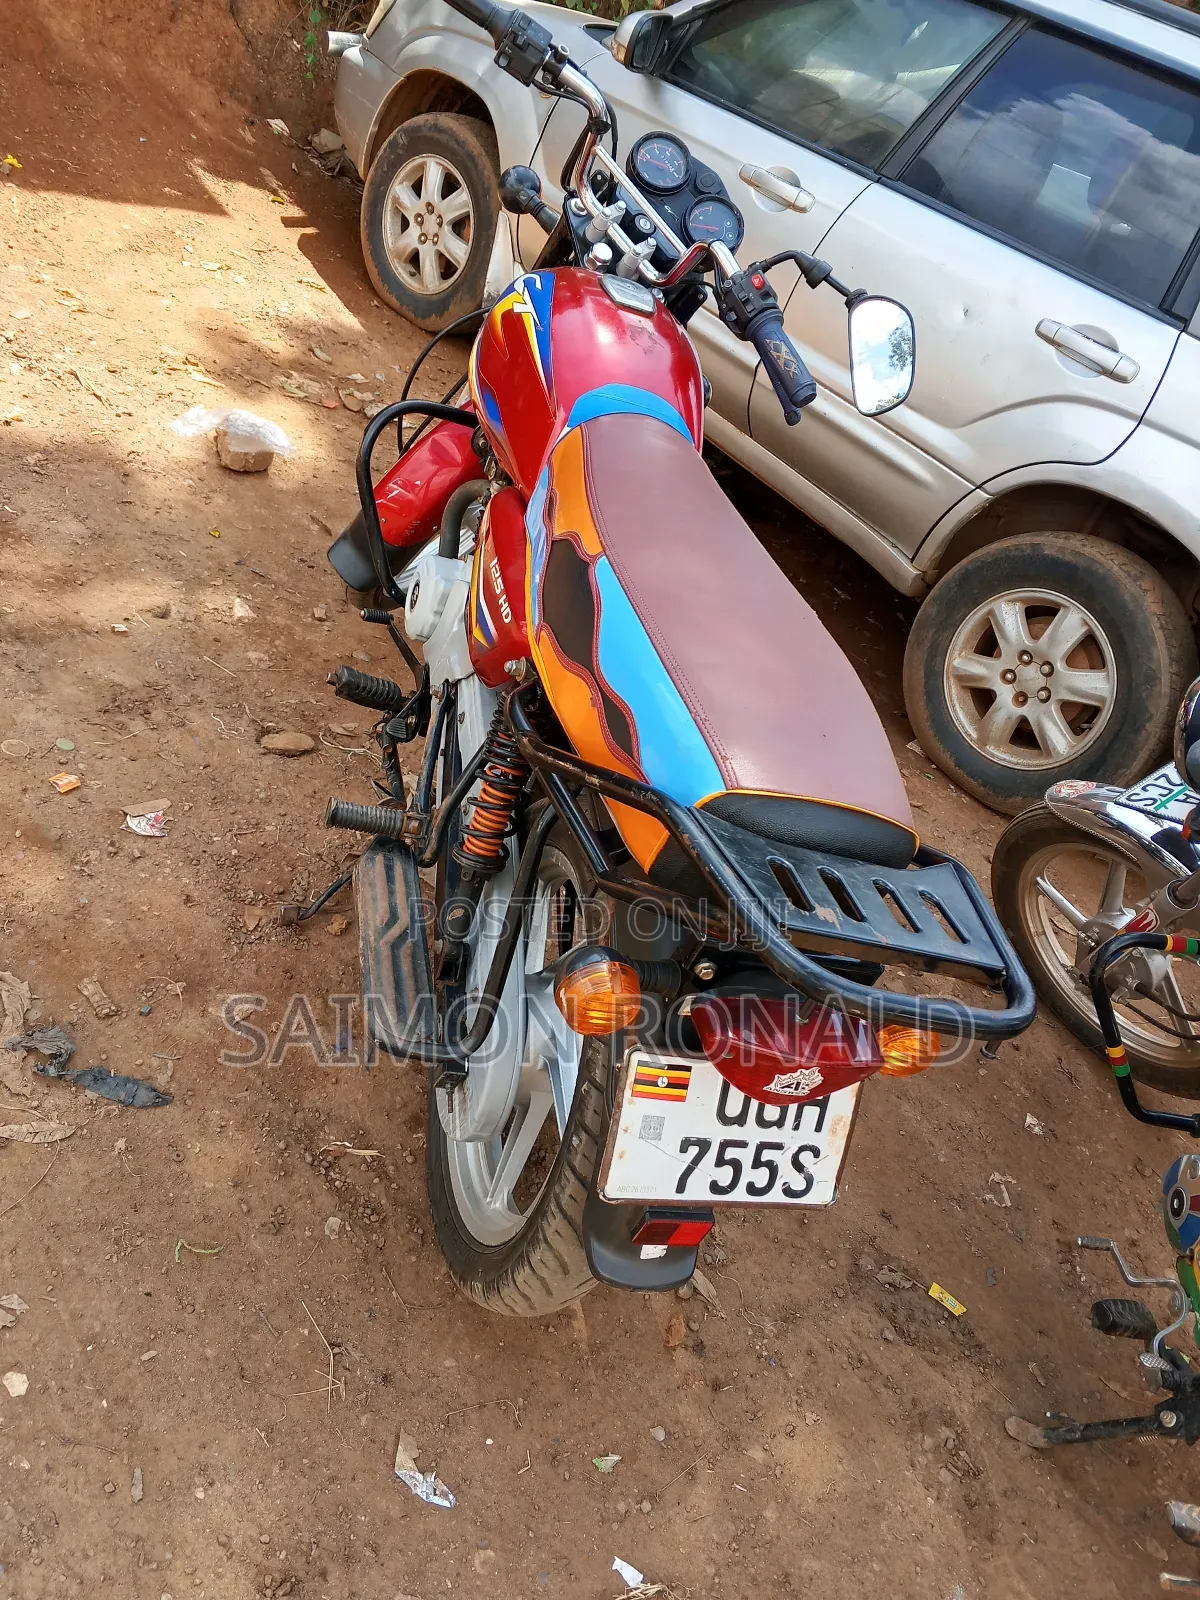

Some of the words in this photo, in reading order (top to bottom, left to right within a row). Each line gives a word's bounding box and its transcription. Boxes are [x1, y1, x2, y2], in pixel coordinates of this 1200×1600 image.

[489, 557, 505, 595] 125
[498, 594, 513, 624] HD
[674, 1136, 821, 1199] 755S
